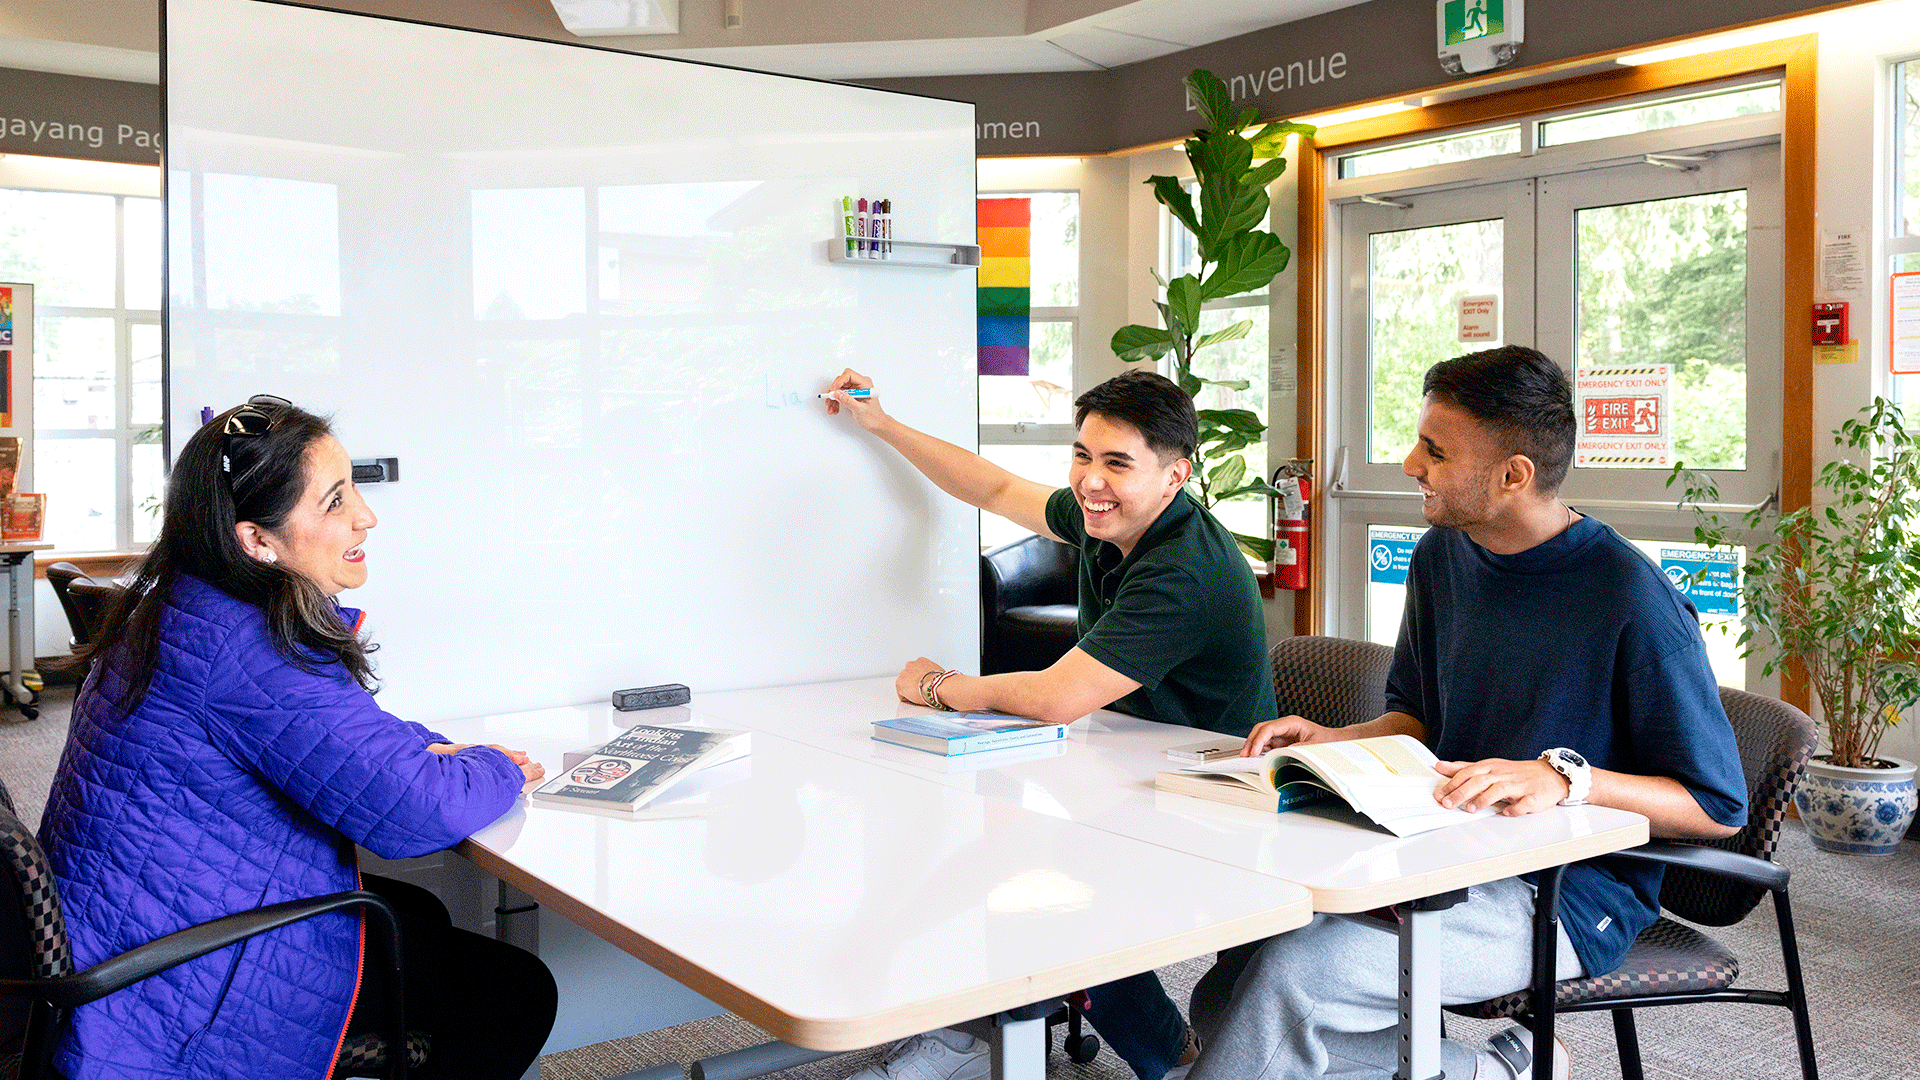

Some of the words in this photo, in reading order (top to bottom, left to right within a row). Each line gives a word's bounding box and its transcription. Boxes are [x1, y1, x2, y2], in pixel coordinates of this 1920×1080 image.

[1186, 52, 1347, 111] nvenue
[976, 121, 1040, 139] men
[1577, 380, 1624, 389] EMERGENCY
[1644, 378, 1668, 387] ONLY
[1602, 402, 1629, 415] FIRE
[1602, 417, 1630, 430] EXIT
[1577, 442, 1624, 450] EMERGENCY
[1626, 442, 1642, 450] EXIT
[1644, 442, 1667, 450] ONLY
[1371, 531, 1411, 540] EMERGENCY
[1411, 533, 1424, 541] EX
[1661, 550, 1717, 560] EMERGENCY
[1718, 552, 1738, 561] EXIT
[1699, 589, 1714, 597] front
[631, 726, 685, 740] Looking
